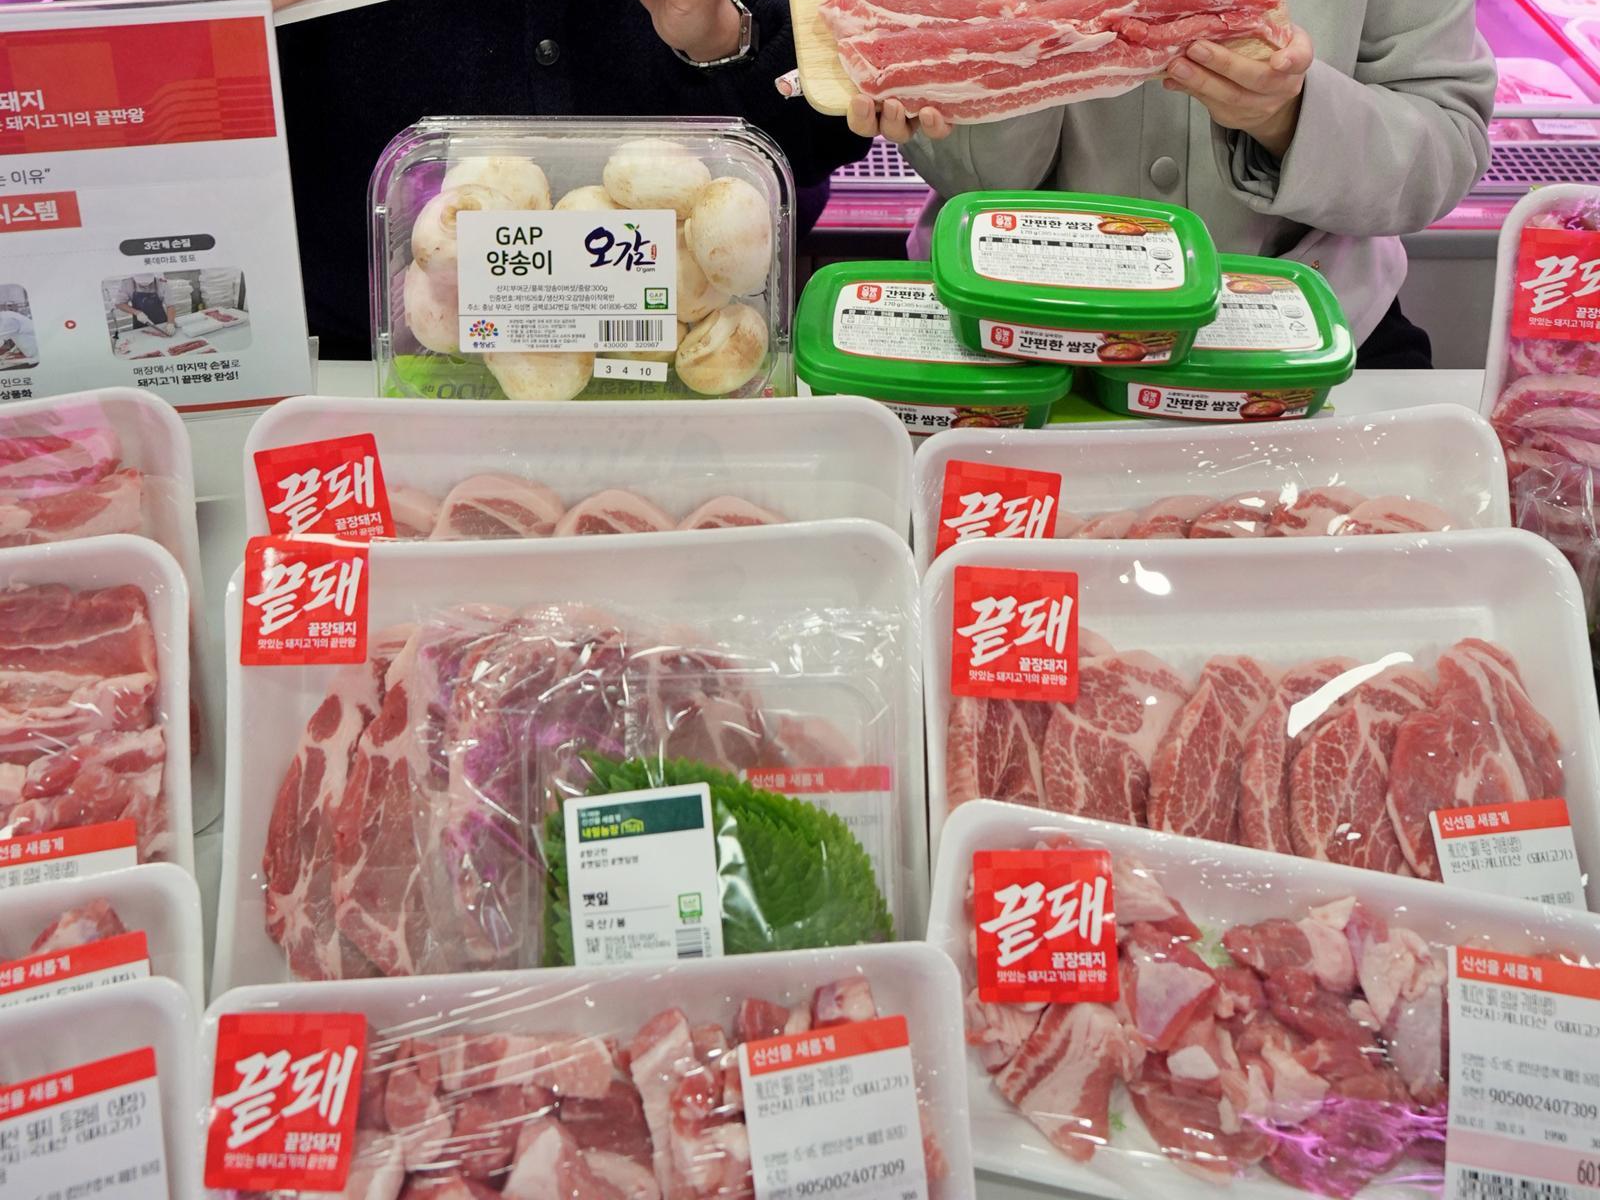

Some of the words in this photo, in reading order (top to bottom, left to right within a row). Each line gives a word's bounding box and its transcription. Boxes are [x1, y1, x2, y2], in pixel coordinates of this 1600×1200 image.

[6, 111, 91, 131] 돼지고기의
[94, 108, 145, 126] 끝판왕
[1020, 218, 1062, 229] 간편한
[1065, 221, 1094, 231] 쌈장
[144, 240, 170, 250] 3단계
[171, 238, 191, 249] 손질
[496, 226, 543, 246] GAP
[487, 250, 552, 276] 양송이
[886, 290, 926, 300] 간편한
[1529, 316, 1553, 327] 맛있는
[1019, 335, 1064, 352] 간편한
[1066, 341, 1097, 354] 쌈장
[133, 364, 175, 375] 매장에서
[177, 361, 208, 373] 마지막
[209, 359, 240, 371] 손질로
[606, 365, 612, 374] 3
[622, 366, 628, 375] 4
[640, 368, 652, 377] 10
[137, 376, 179, 388] 돼지고기
[181, 373, 212, 385] 끝판왕
[214, 371, 239, 383] 완성!
[1166, 396, 1208, 412] 간편한
[1211, 400, 1240, 412] 쌈장
[920, 414, 951, 427] 쌈장
[269, 456, 375, 540] 끝돼
[335, 511, 382, 531] 끝장돼지
[942, 491, 1054, 544] 끝돼
[247, 557, 364, 636] 끝돼
[307, 621, 357, 637] 끝장돼지
[956, 595, 1074, 667] 끝돼
[258, 637, 284, 649] 맛있는
[285, 637, 329, 649] 돼지고기의
[330, 637, 357, 649] 끝판왕
[1019, 657, 1067, 673] 끝장돼지
[969, 669, 994, 682] 맛있는
[996, 672, 1040, 684] 돼지고기의
[1041, 673, 1067, 686] 끝판왕
[1442, 816, 1476, 832] 신선을
[1478, 811, 1511, 828] 새롭게
[26, 836, 64, 855] 새롭게
[583, 891, 608, 907] 깻잎
[585, 918, 607, 930] 국산
[979, 876, 1107, 967] 끝돼
[29, 955, 71, 978] 새롭게
[1052, 951, 1106, 968] 끝장돼지
[1461, 955, 1500, 977] 신선을
[1502, 962, 1543, 983] 새롭게
[997, 970, 1026, 983] 맛있는
[1028, 970, 1076, 983] 돼지고기의
[752, 1043, 793, 1067] 신선을
[796, 1035, 836, 1057] 새롭게
[215, 1045, 358, 1149] 끝돼
[1488, 1087, 1598, 1120] 905002407309
[284, 1131, 342, 1153] 끝장돼지
[796, 1158, 905, 1197] 905002407309
